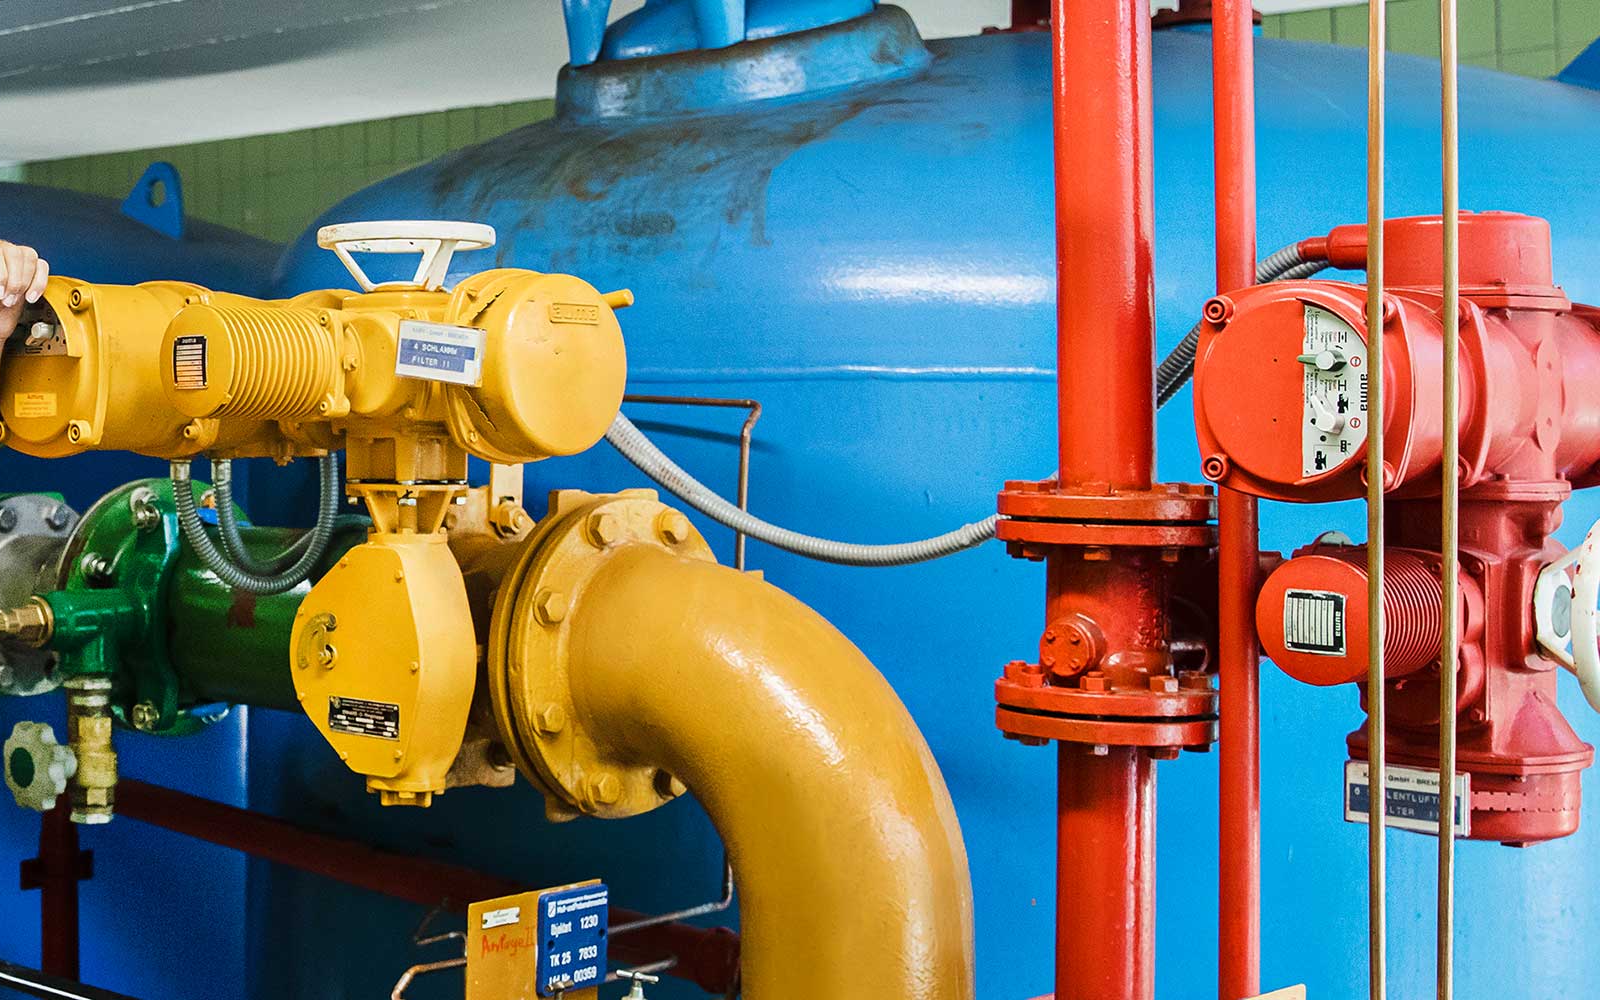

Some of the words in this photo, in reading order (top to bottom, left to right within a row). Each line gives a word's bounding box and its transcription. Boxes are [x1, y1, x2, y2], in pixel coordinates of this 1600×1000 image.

[411, 355, 439, 367] FILTER
[580, 914, 598, 929] 1230
[550, 954, 560, 967] TK
[561, 951, 572, 966] 25
